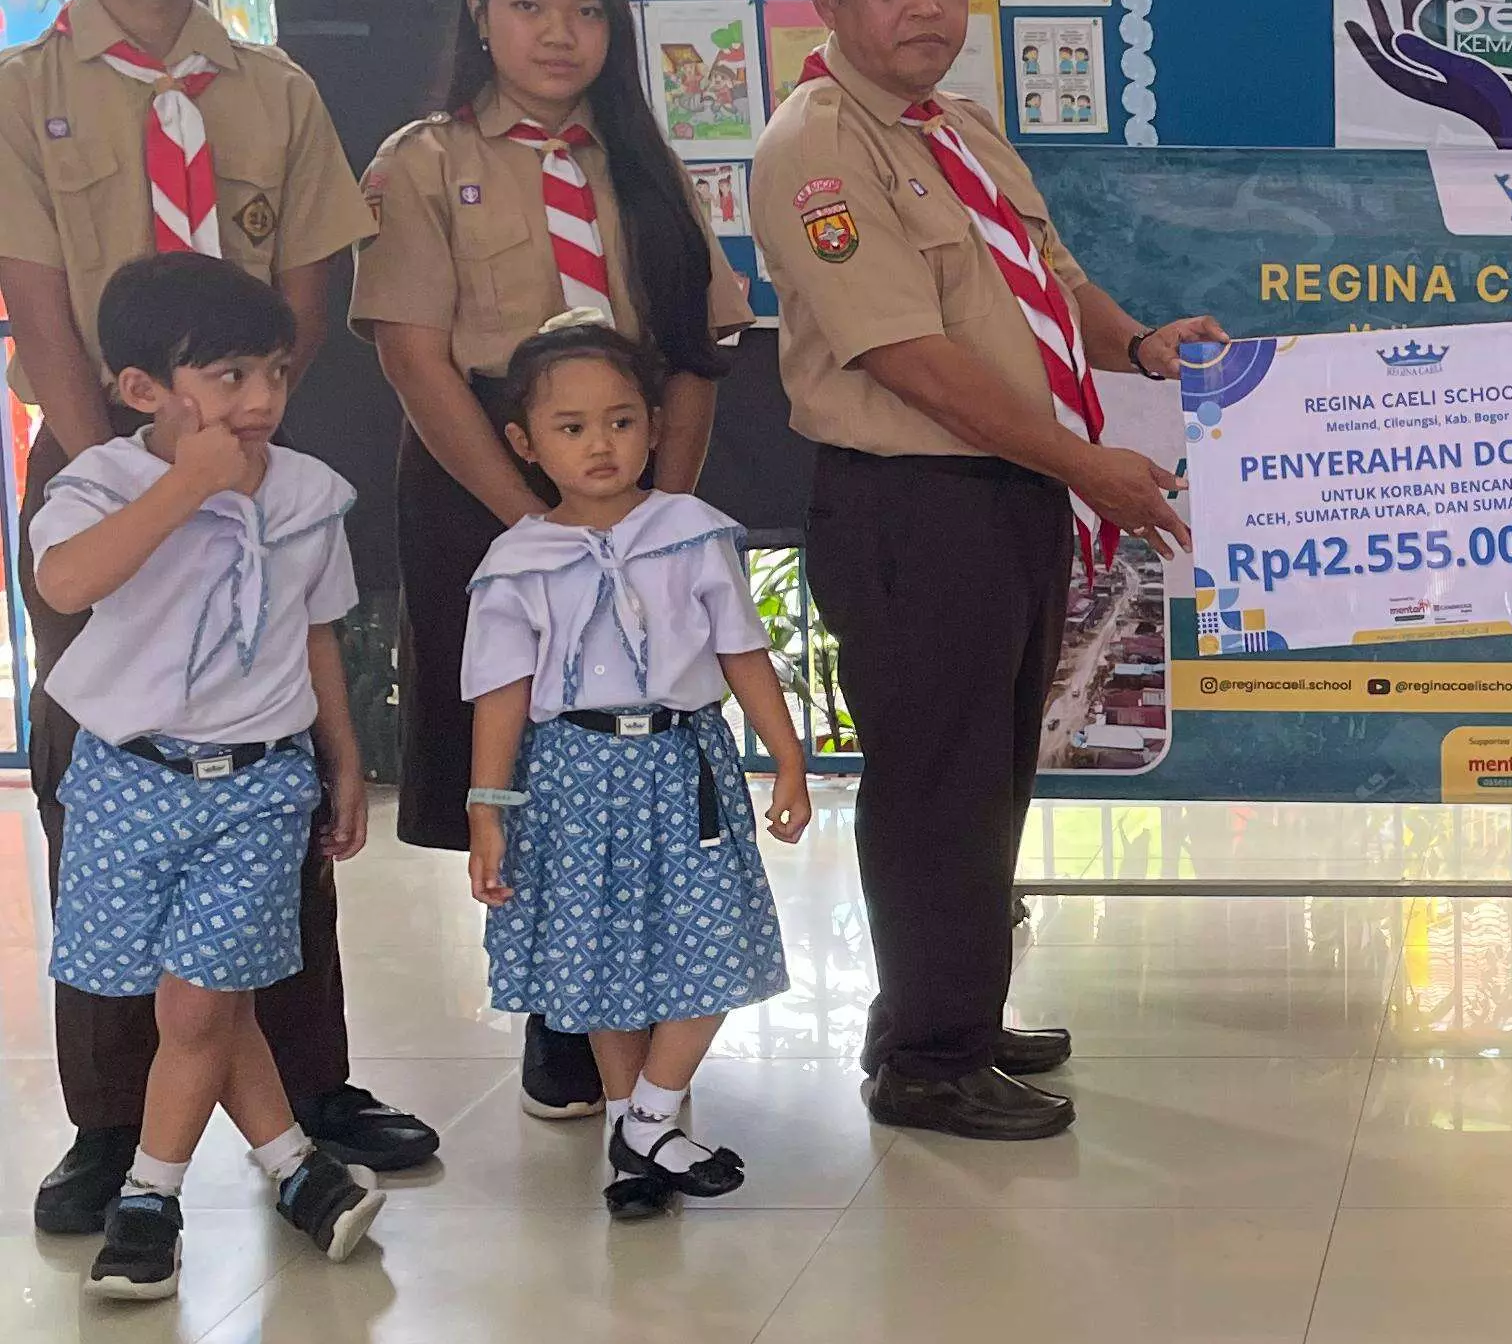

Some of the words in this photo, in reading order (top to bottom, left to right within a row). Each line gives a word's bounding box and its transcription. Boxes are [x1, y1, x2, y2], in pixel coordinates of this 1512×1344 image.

[1260, 262, 1456, 304] REGINA
[1304, 394, 1376, 414] REGINA
[1381, 389, 1437, 409] CAELI
[1326, 418, 1381, 433] Metland,
[1474, 410, 1510, 425] Bogor
[1240, 442, 1463, 483] PENYERAHAN
[1320, 485, 1376, 503] UNTUK
[1380, 481, 1446, 500] KORBAN
[1245, 511, 1291, 528] ACEH,
[1295, 507, 1371, 525] SUMATRA
[1374, 502, 1431, 520] UTARA,
[1435, 500, 1469, 516] DAN
[1468, 736, 1510, 747] Supported
